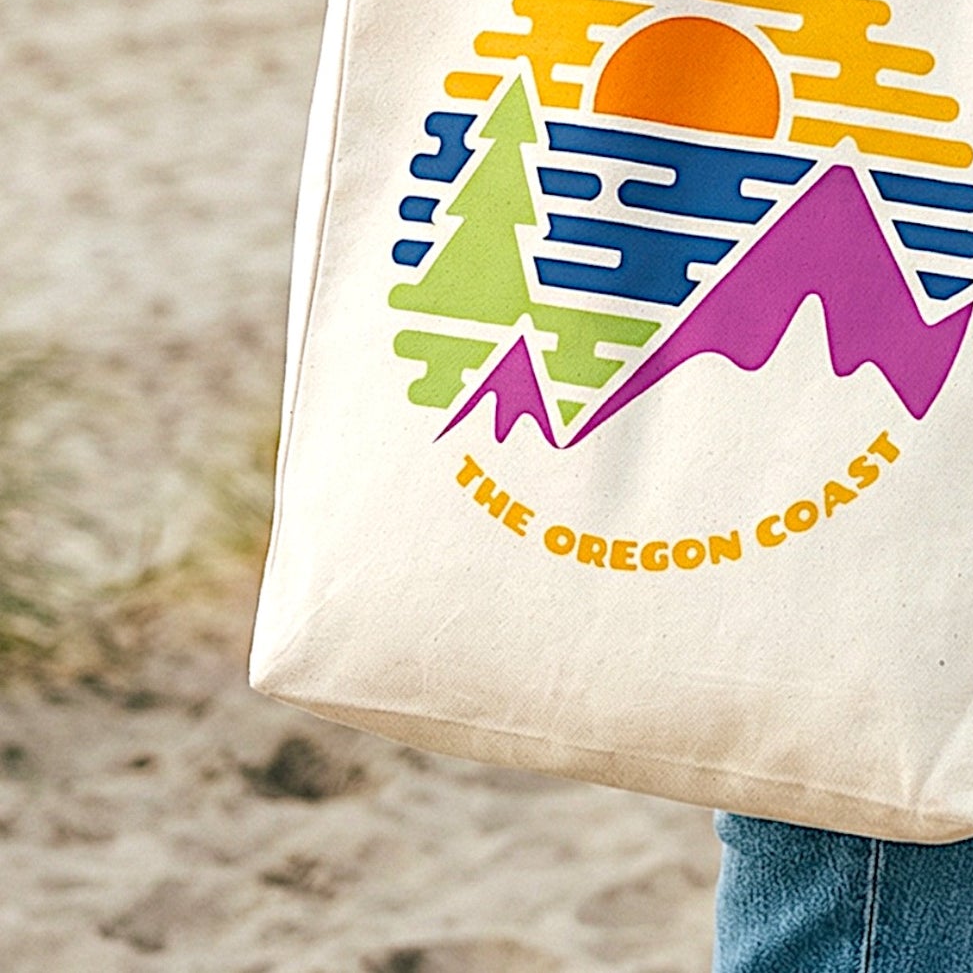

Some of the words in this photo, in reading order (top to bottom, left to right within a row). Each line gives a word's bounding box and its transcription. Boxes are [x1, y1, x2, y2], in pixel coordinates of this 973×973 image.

[455, 454, 535, 537] THE
[543, 525, 743, 572] OREGON
[755, 430, 900, 548] COAST
